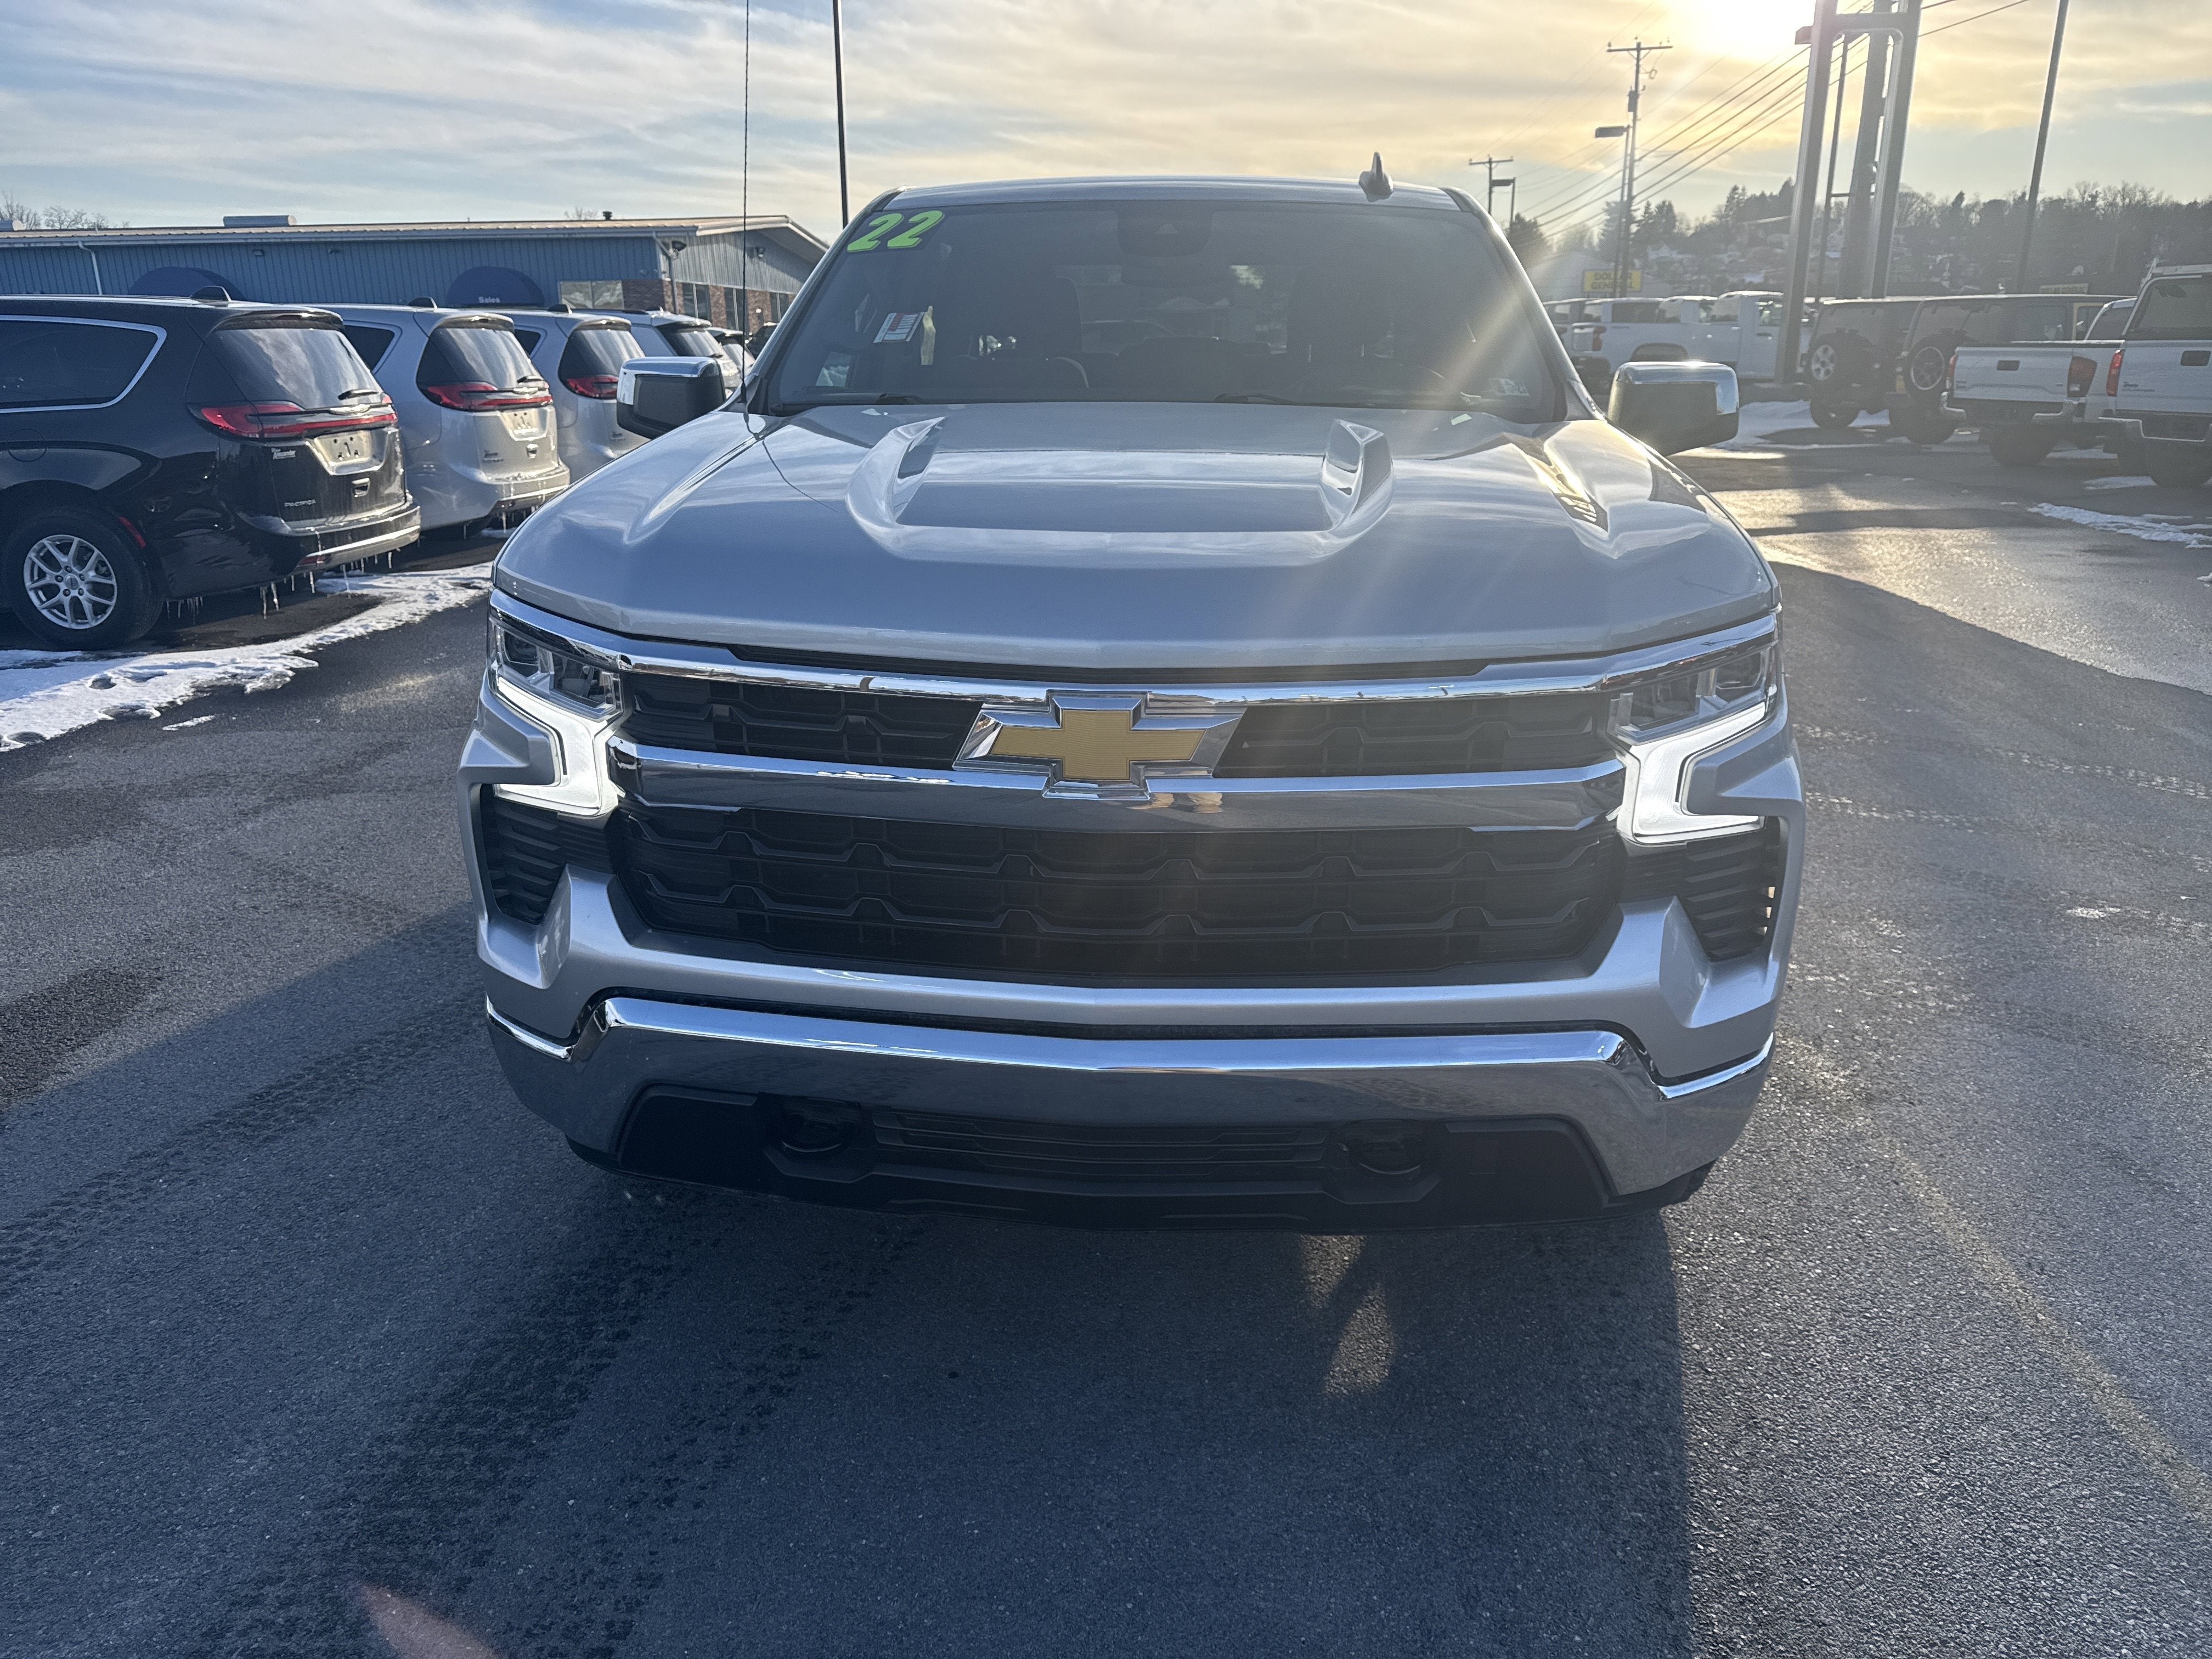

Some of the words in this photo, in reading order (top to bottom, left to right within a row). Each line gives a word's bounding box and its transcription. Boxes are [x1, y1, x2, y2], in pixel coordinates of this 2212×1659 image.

[847, 210, 945, 252] 22
[1594, 272, 1633, 280] DOLR
[1590, 281, 1635, 290] GENEL
